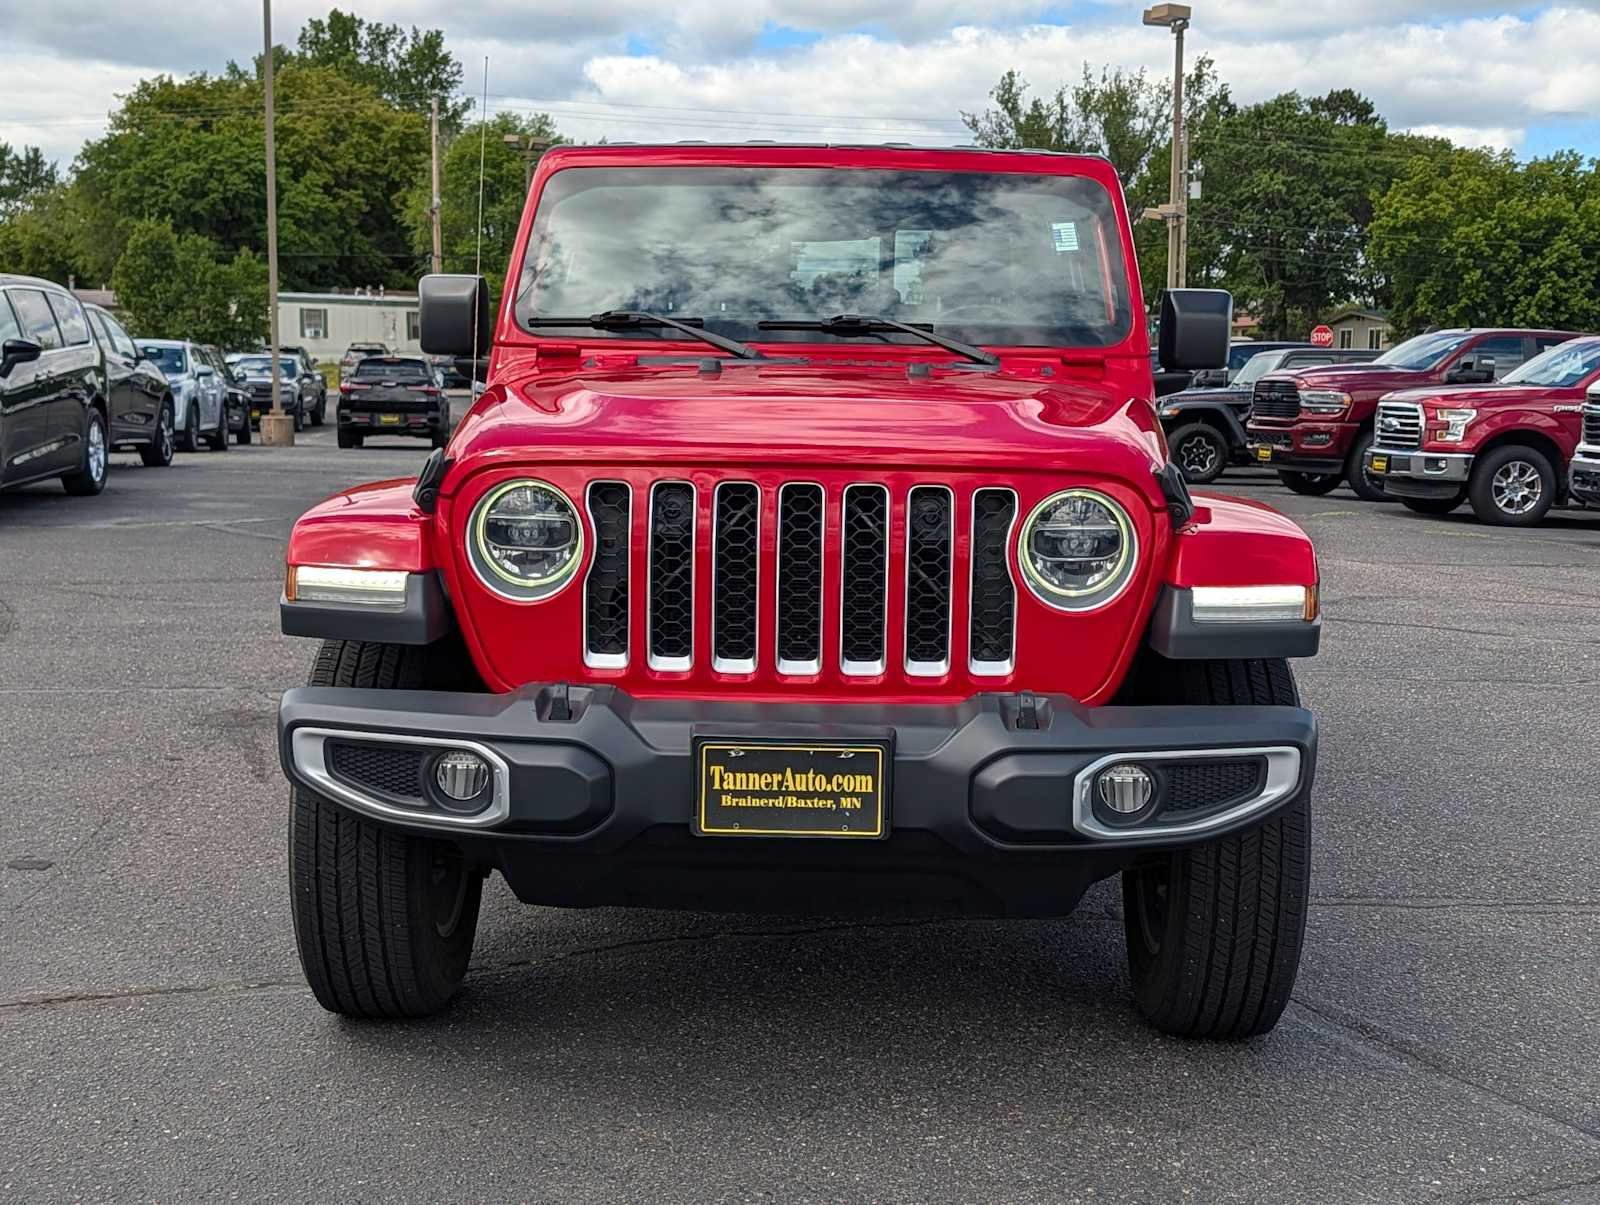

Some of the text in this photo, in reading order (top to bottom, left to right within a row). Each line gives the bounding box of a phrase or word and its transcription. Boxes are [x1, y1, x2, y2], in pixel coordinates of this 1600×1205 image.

[1312, 332, 1331, 342] STOP
[710, 766, 873, 792] TannerAuto.com
[720, 794, 861, 811] Brainerd/Baxter, MN
